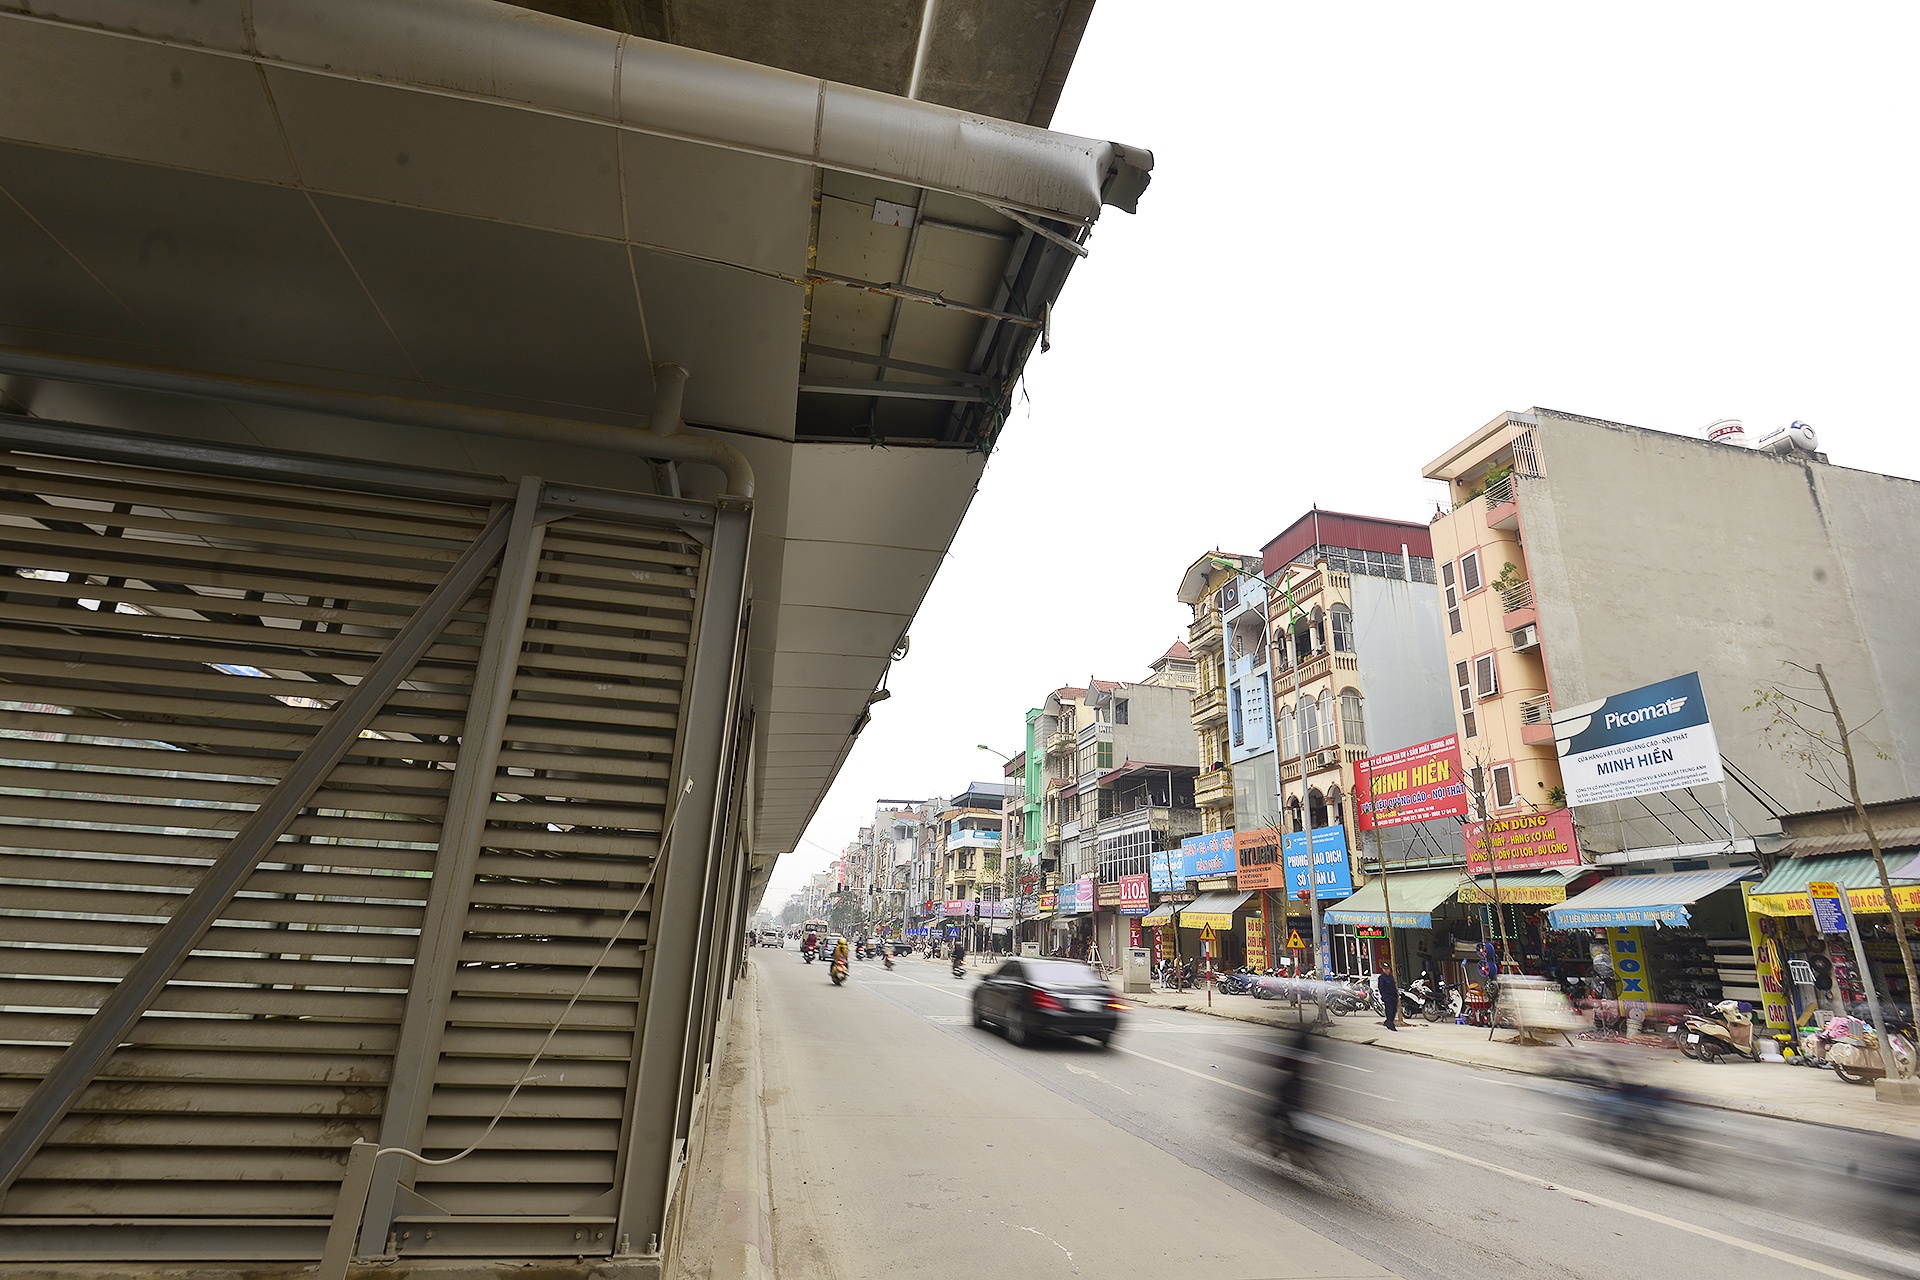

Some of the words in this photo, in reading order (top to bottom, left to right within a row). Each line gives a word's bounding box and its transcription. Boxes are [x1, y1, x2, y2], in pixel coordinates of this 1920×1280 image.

[1605, 697, 1678, 730] Picomat
[1597, 757, 1635, 776] MINH
[1638, 747, 1674, 768] HIỀN
[1369, 769, 1408, 796] MINH
[1411, 755, 1450, 788] HIỀN
[1511, 814, 1548, 831] DŨNG
[1287, 852, 1309, 869] PHÒNG
[1325, 849, 1343, 868] DỊCH
[1297, 869, 1307, 886] SỐ
[1327, 870, 1337, 884] LA
[1120, 881, 1147, 900] LiOA
[1786, 897, 1806, 911] HÀNG
[1867, 891, 1884, 907] CÁC
[1768, 1001, 1785, 1022] CÁC
